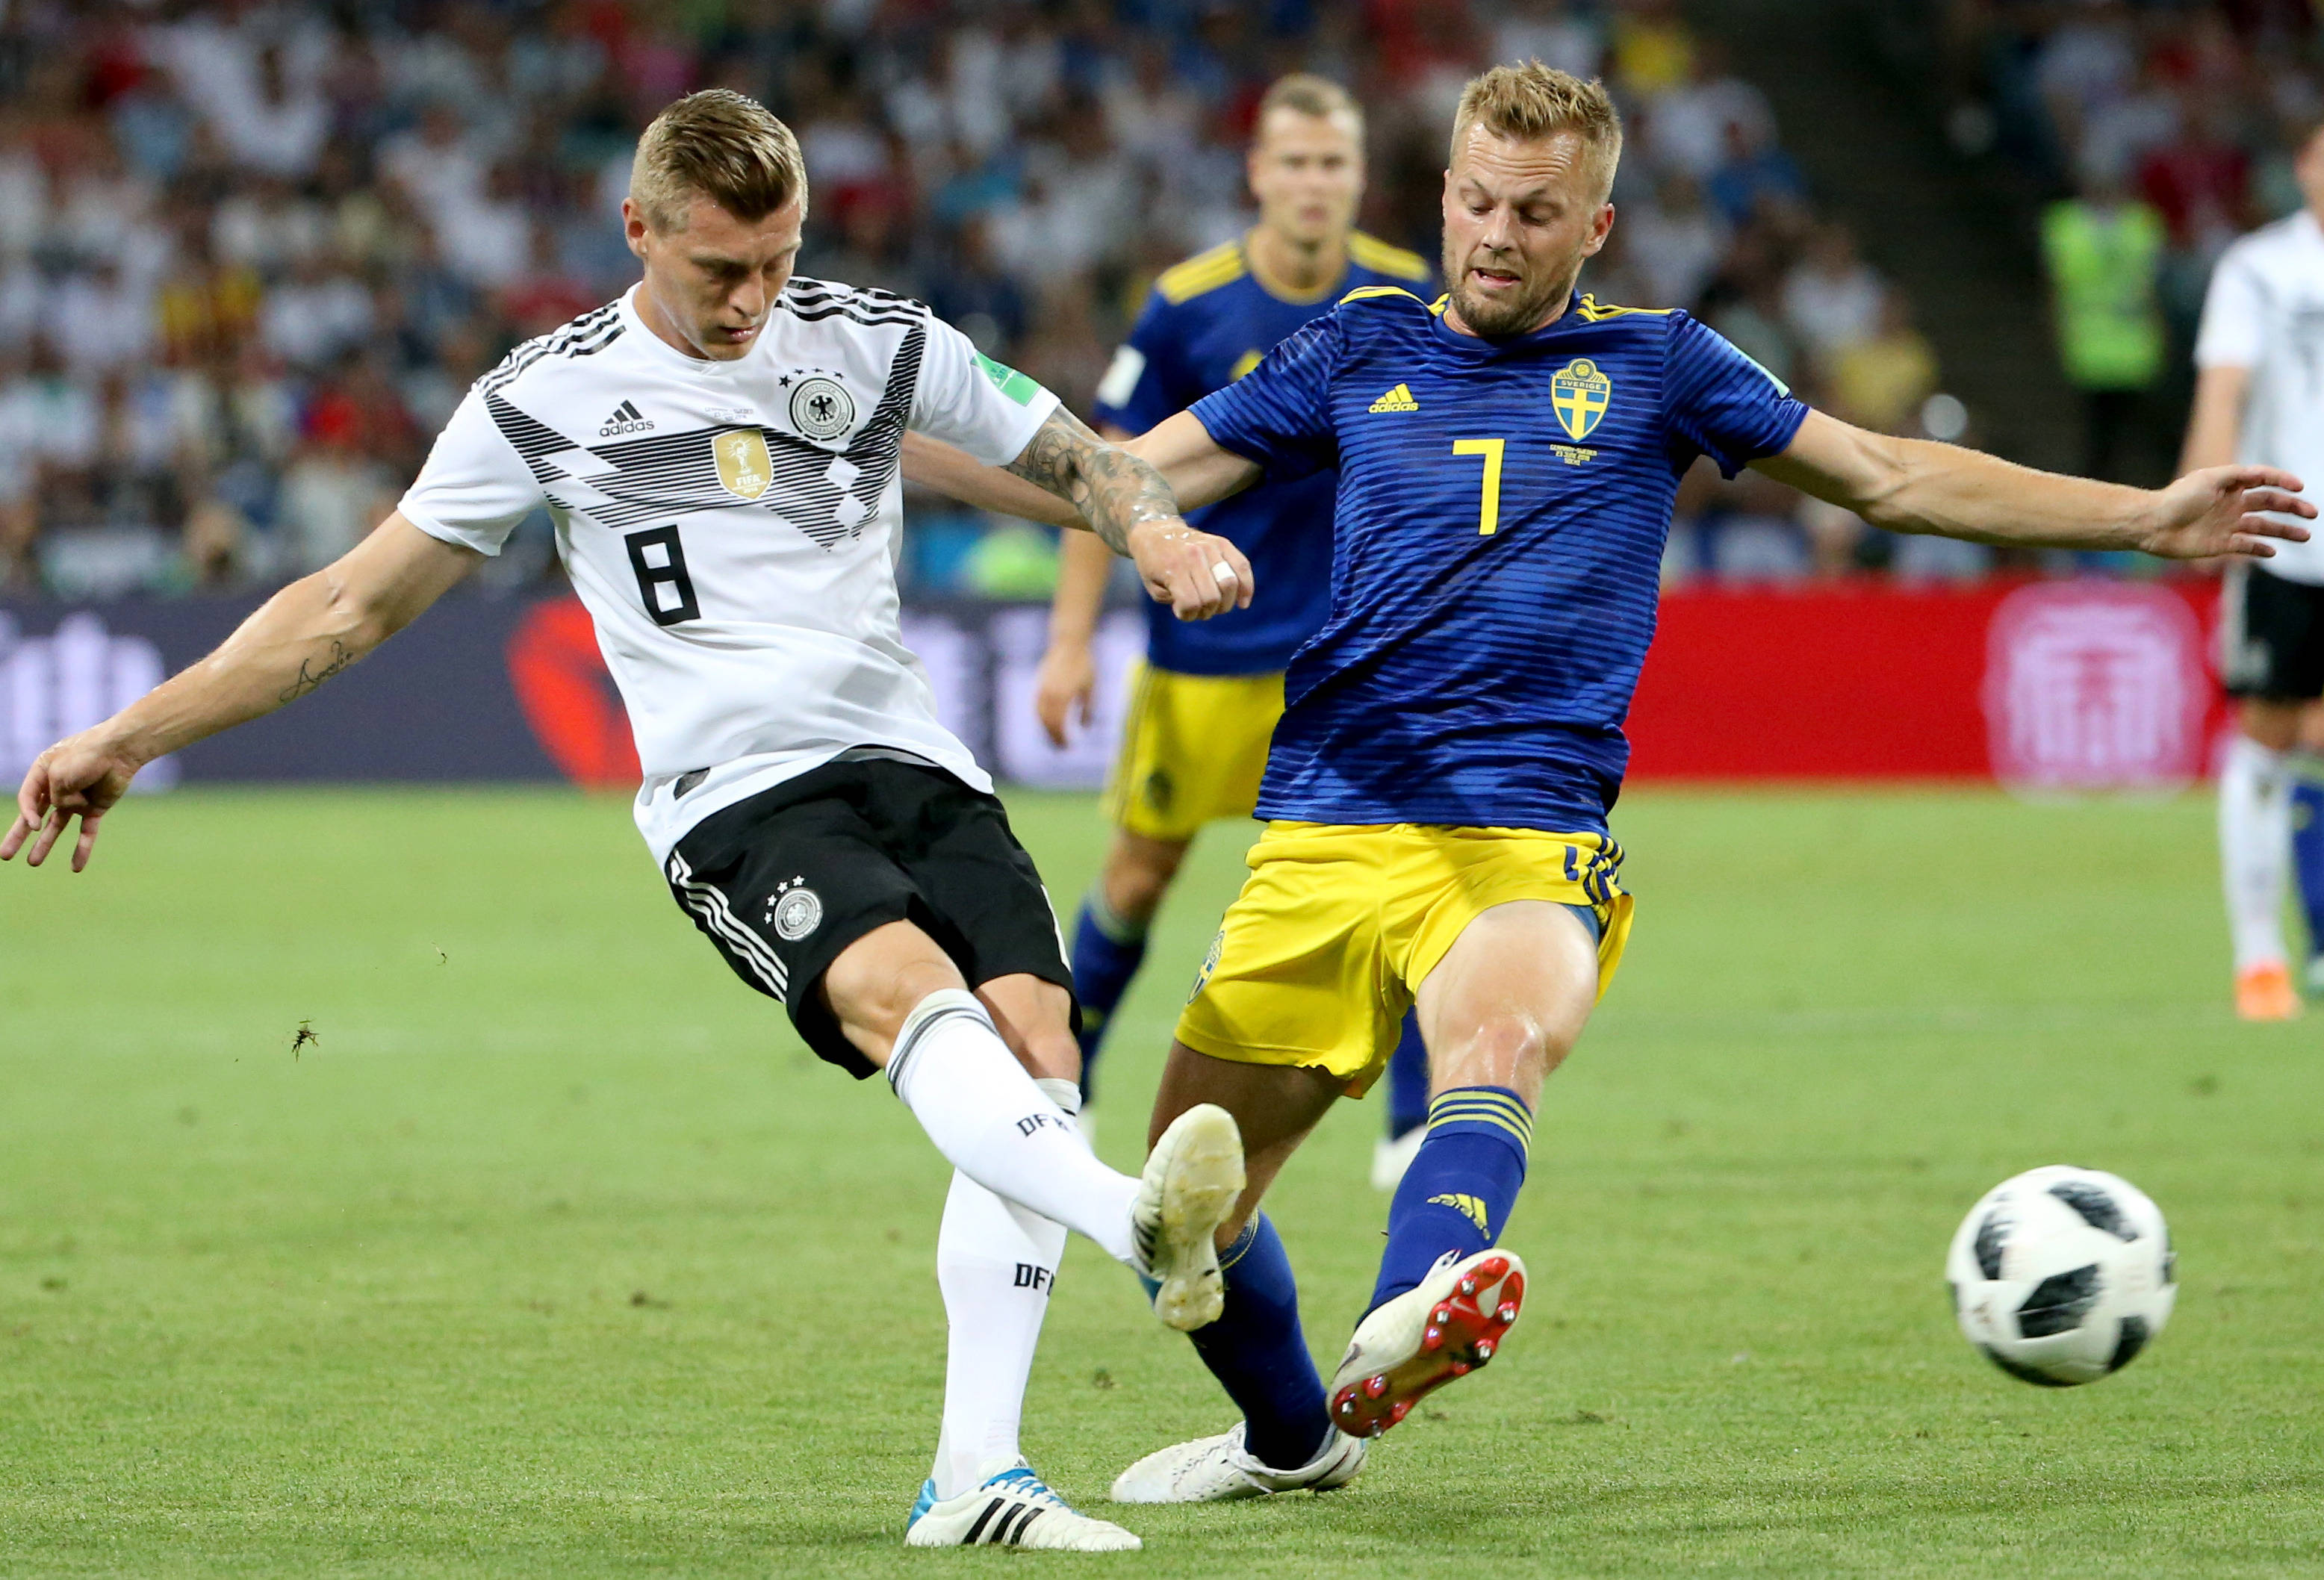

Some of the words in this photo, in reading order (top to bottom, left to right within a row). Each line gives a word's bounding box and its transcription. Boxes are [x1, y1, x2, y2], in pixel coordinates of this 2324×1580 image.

[1560, 379, 1603, 391] SVERIGE
[1368, 402, 1419, 414] adidas
[600, 420, 655, 437] adidas
[736, 473, 762, 486] FIFA
[1452, 438, 1506, 535] 7
[624, 524, 701, 626] 8
